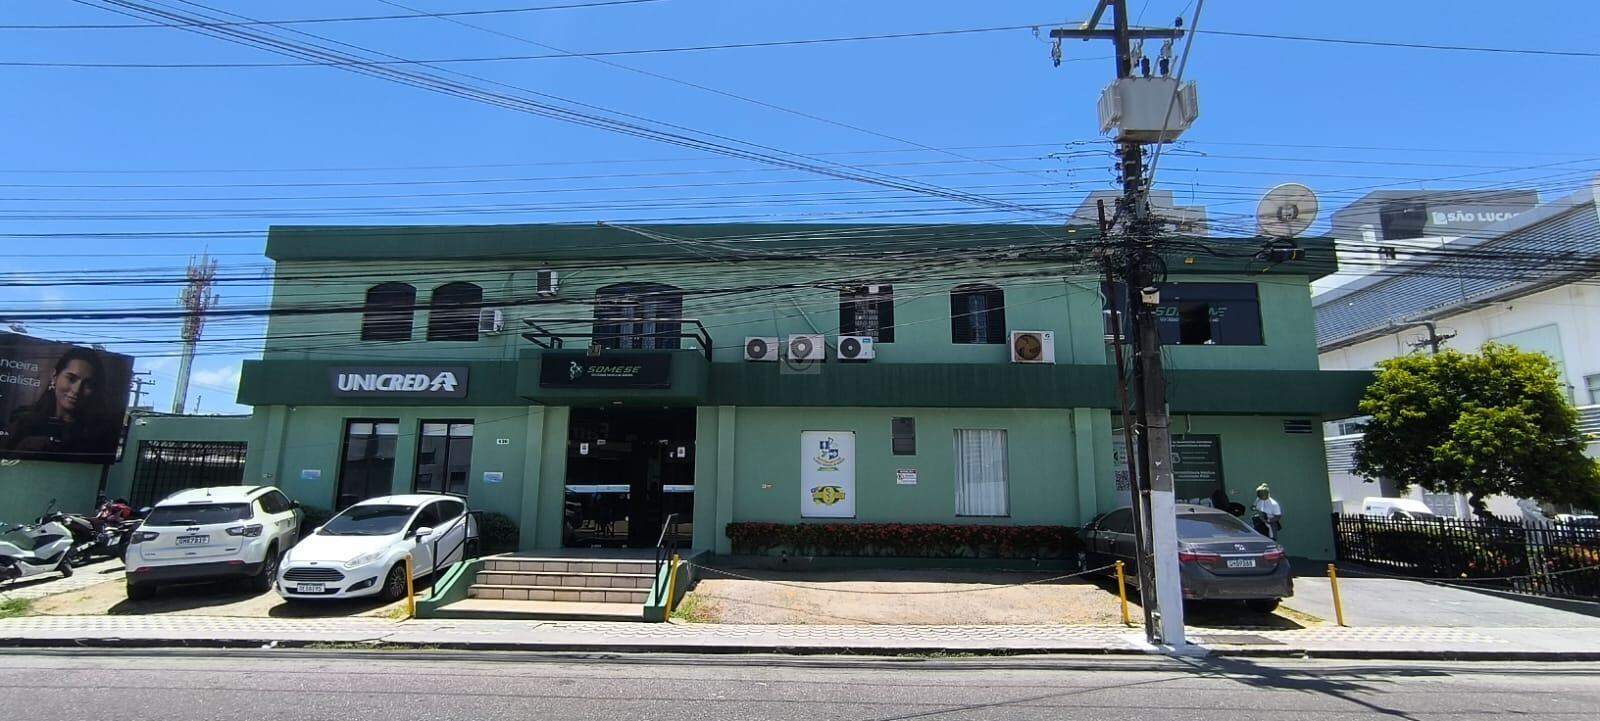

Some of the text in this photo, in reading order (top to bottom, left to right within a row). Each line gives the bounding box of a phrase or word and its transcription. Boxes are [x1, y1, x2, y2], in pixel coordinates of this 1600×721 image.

[1447, 210, 1475, 222] SÃO
[587, 365, 642, 373] SOMESE
[0, 373, 41, 387] cialista
[338, 373, 430, 391] UNICRED
